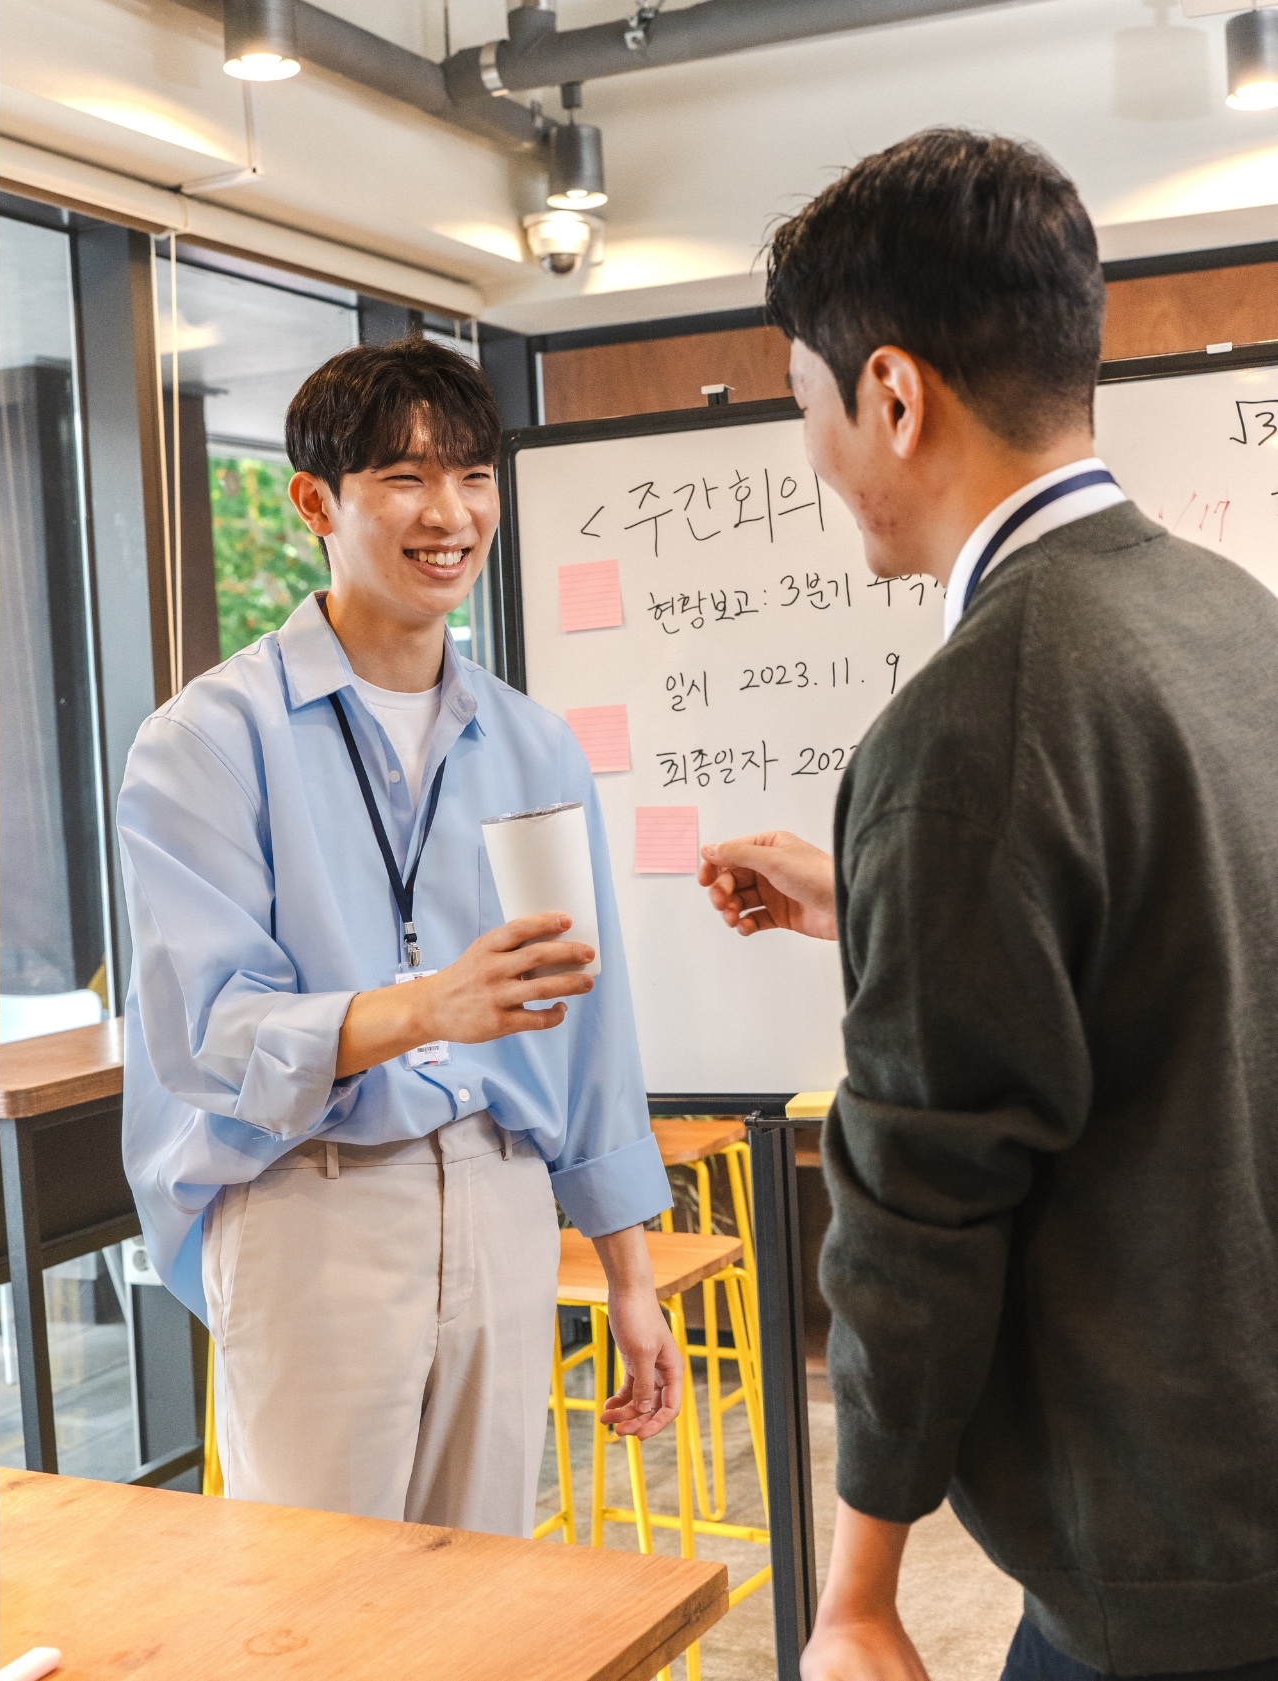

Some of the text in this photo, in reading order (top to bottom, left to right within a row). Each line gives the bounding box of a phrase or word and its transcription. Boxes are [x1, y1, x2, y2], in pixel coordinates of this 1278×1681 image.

[624, 468, 825, 558] 주간회의
[779, 572, 851, 610] 3분기
[665, 671, 709, 712] 일시
[656, 740, 858, 791] 최종일자 202
